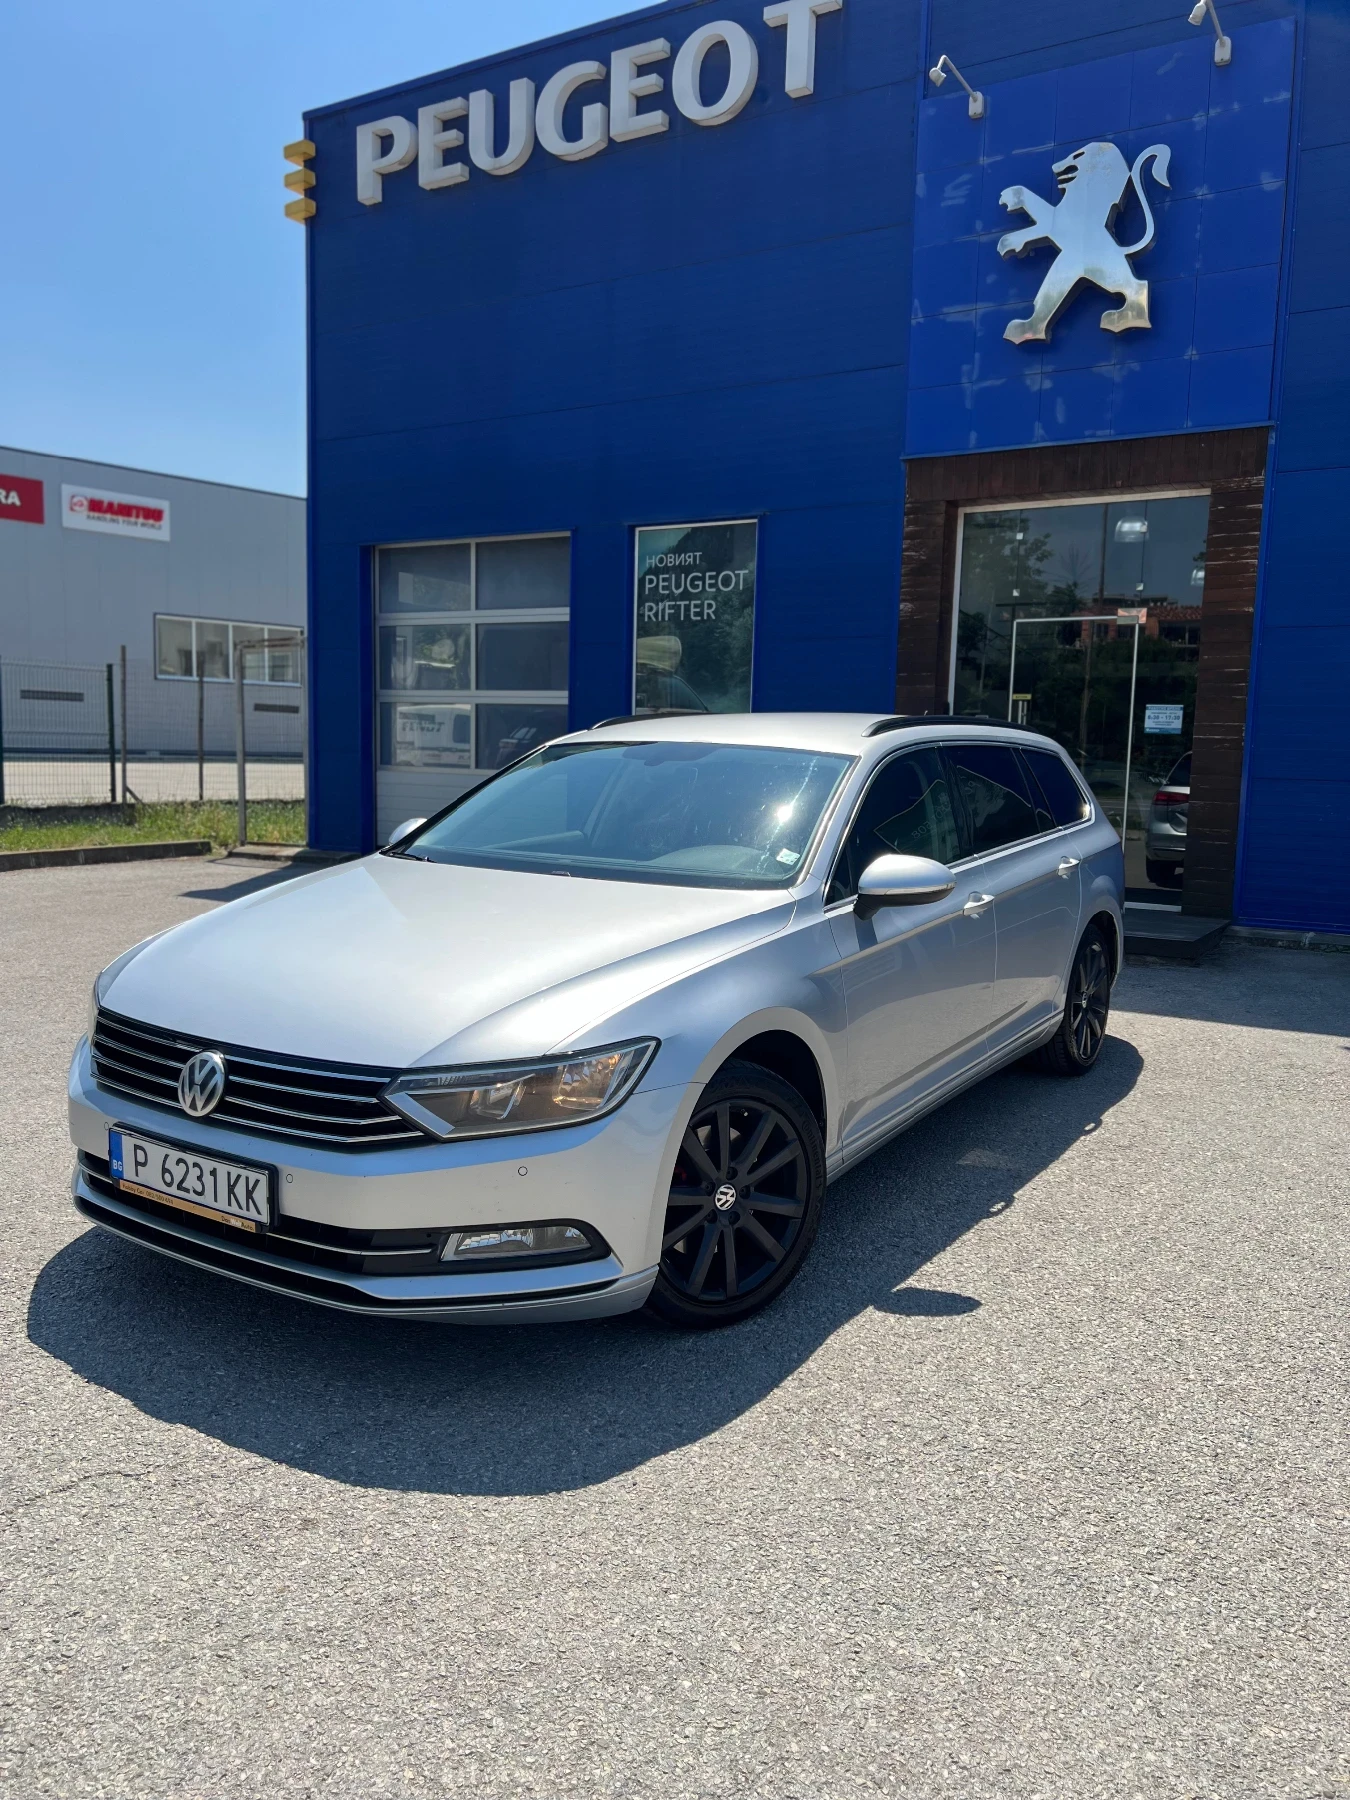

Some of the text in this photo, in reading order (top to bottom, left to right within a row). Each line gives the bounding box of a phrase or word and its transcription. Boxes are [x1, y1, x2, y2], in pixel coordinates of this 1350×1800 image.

[355, 0, 843, 206] PEUGEOT
[88, 498, 164, 523] MANITOU
[646, 552, 702, 568] НОВИЯТ
[645, 570, 749, 596] PEUGEOT
[644, 599, 717, 622] RIFTER
[113, 1159, 123, 1171] BG
[133, 1144, 148, 1178] P
